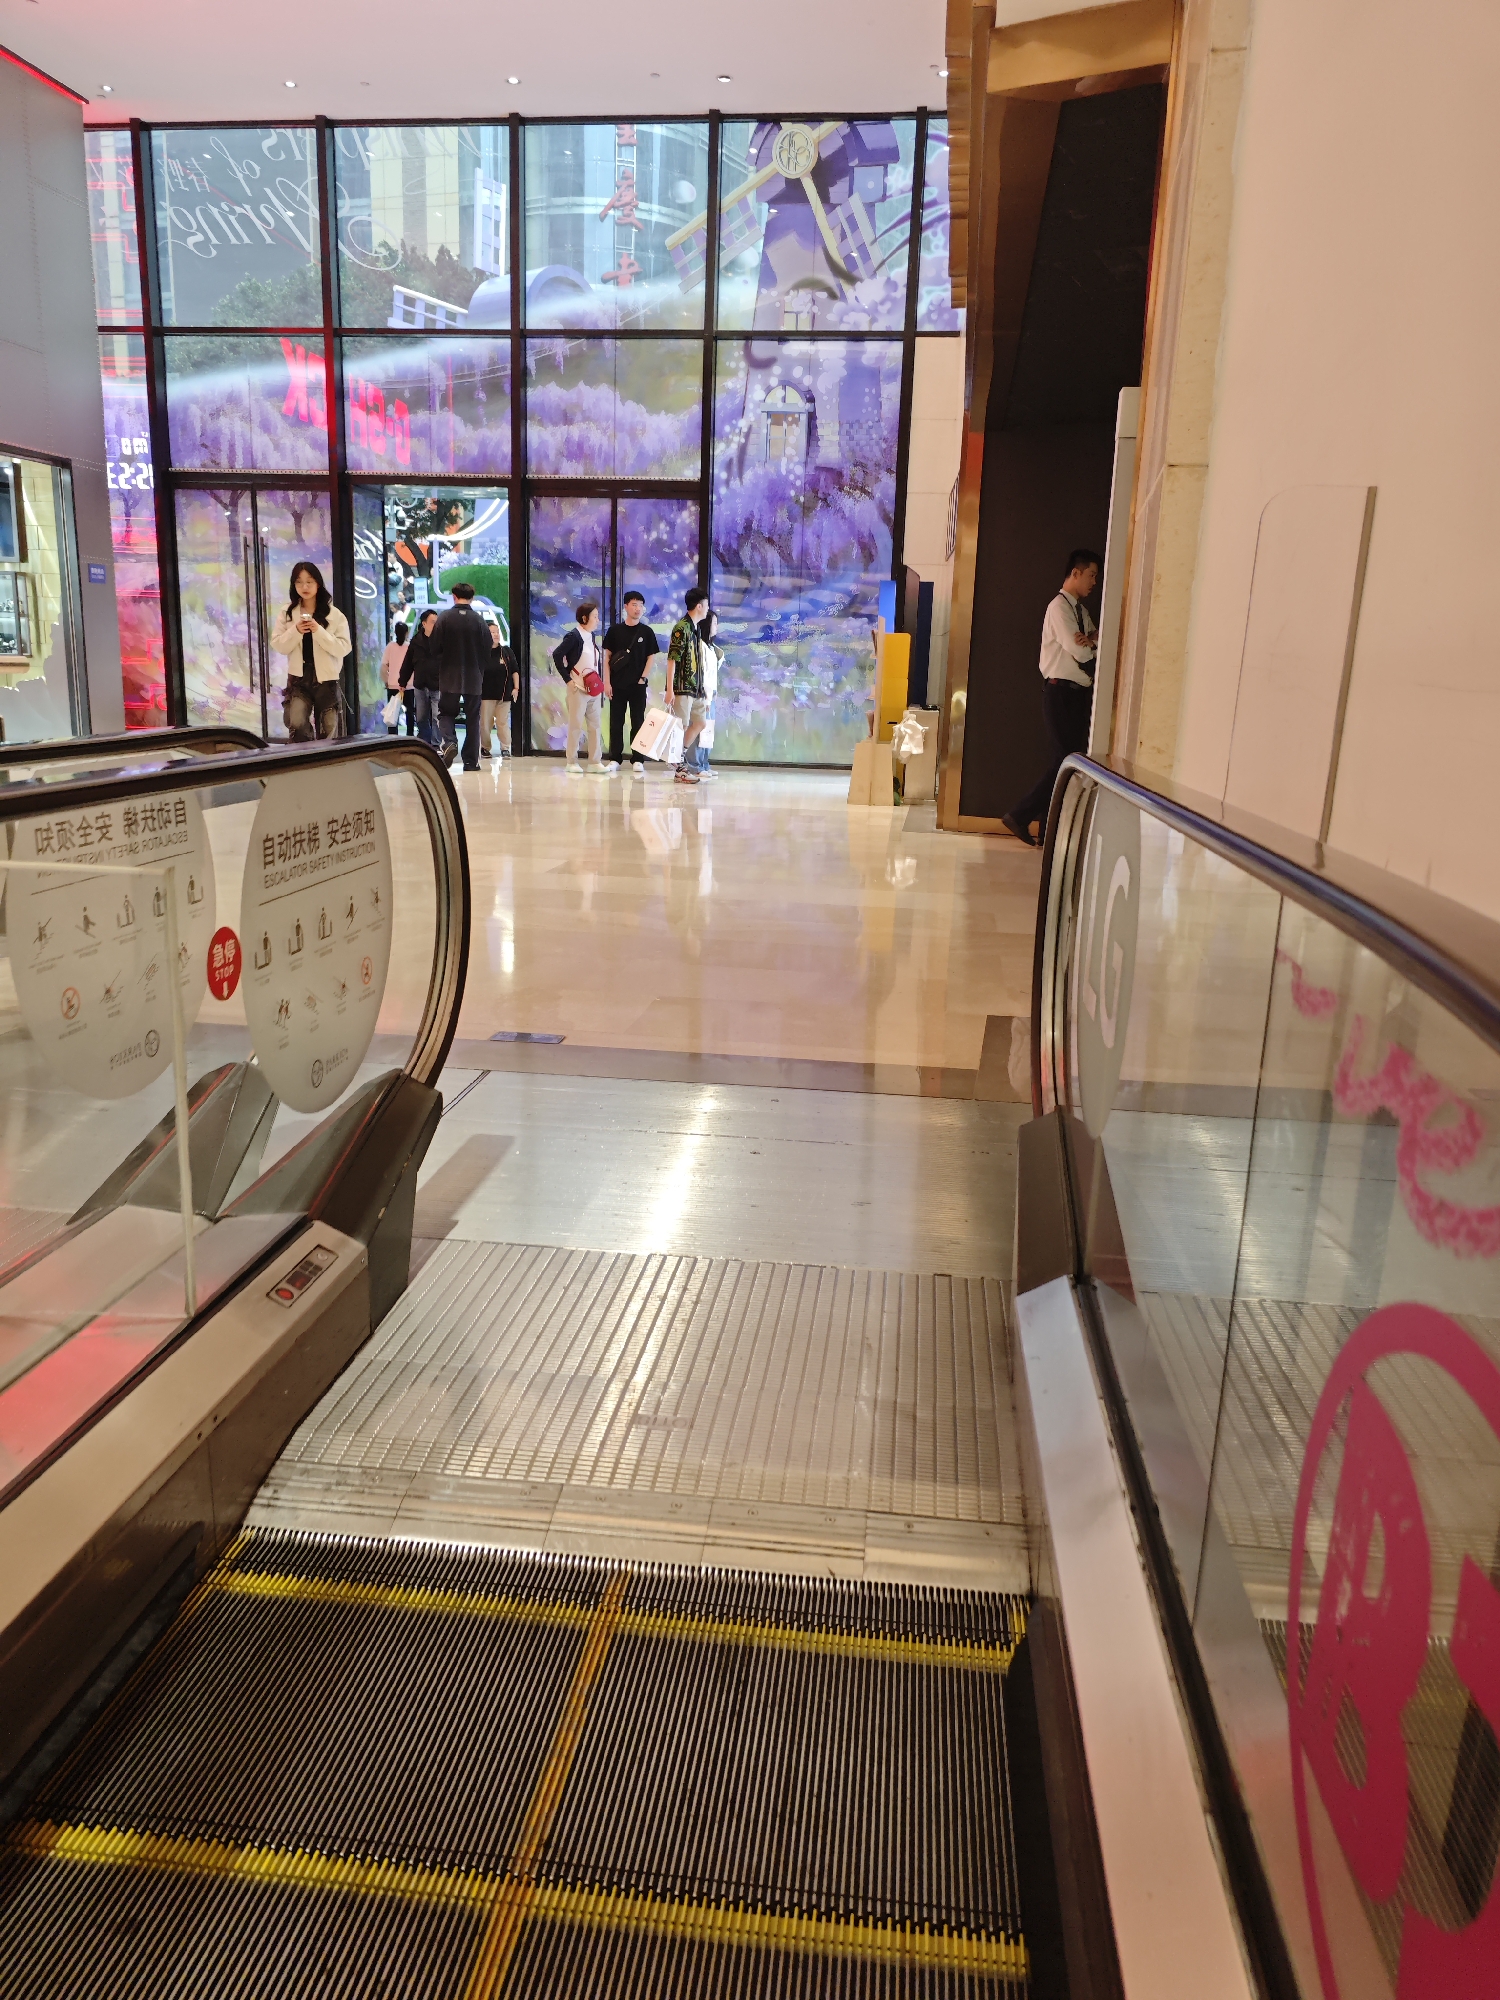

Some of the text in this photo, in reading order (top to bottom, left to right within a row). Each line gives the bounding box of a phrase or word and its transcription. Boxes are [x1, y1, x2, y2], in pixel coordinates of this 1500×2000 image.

[262, 808, 375, 870] 自动扶梯 安全须知
[264, 840, 376, 889] ESCALATOR SAFETY INSTRUCTION
[212, 938, 236, 968] 急停
[1082, 833, 1131, 1049] LG
[214, 964, 235, 982] STOP
